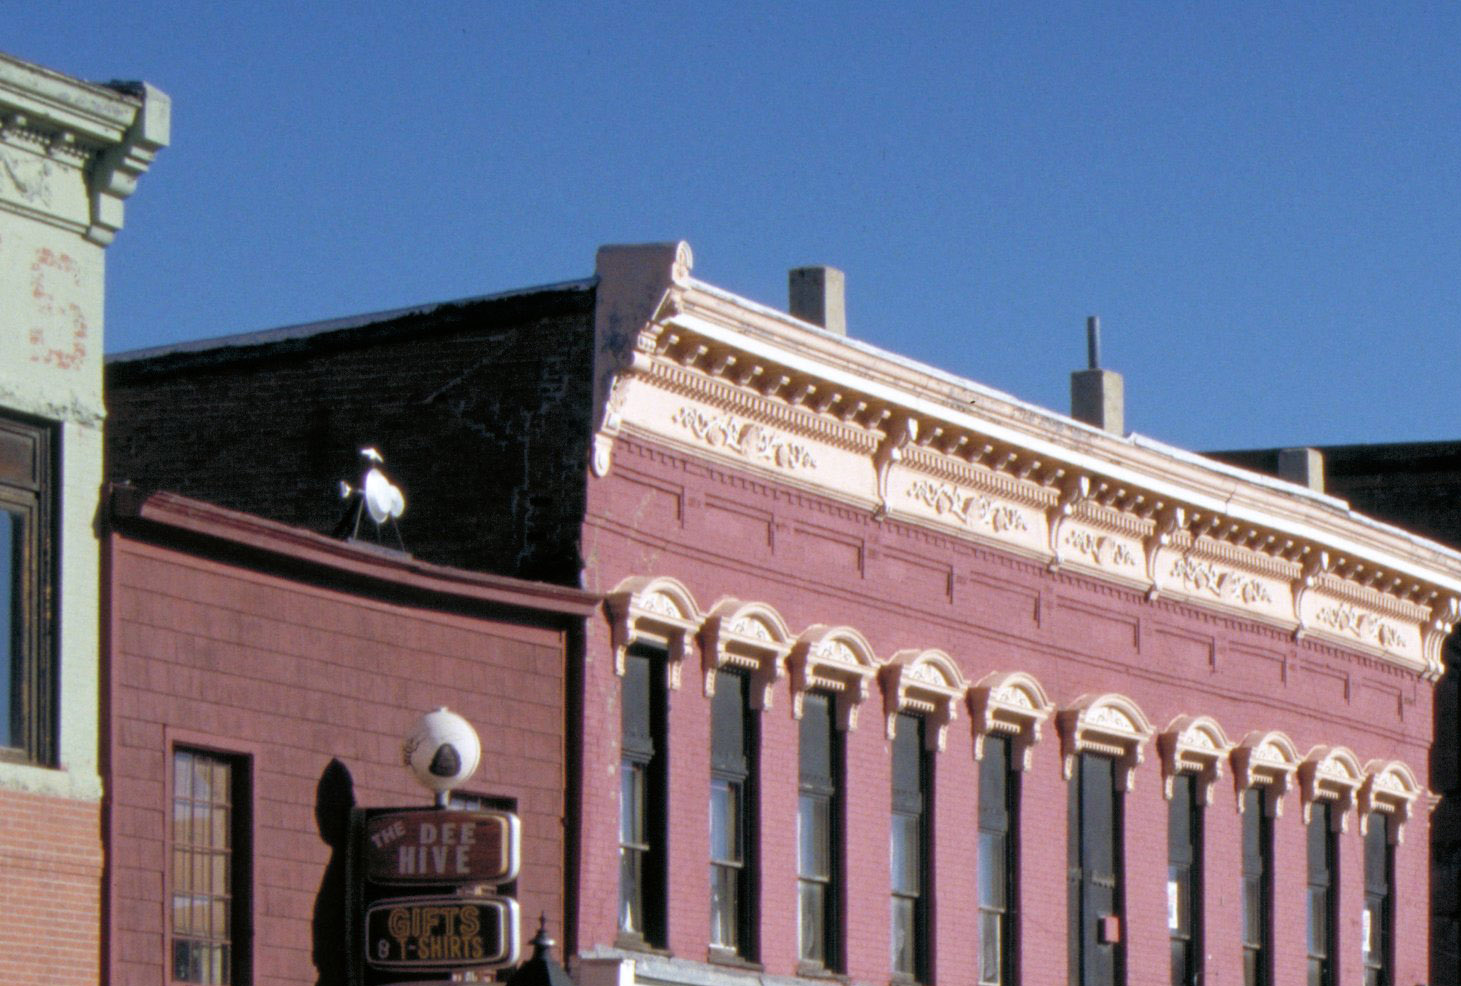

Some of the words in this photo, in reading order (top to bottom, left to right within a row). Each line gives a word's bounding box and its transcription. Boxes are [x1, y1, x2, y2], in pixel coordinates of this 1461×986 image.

[371, 820, 406, 849] THE
[399, 845, 471, 875] HIVE
[388, 904, 480, 939] GIFTS
[397, 935, 485, 961] T-SHIRTS
